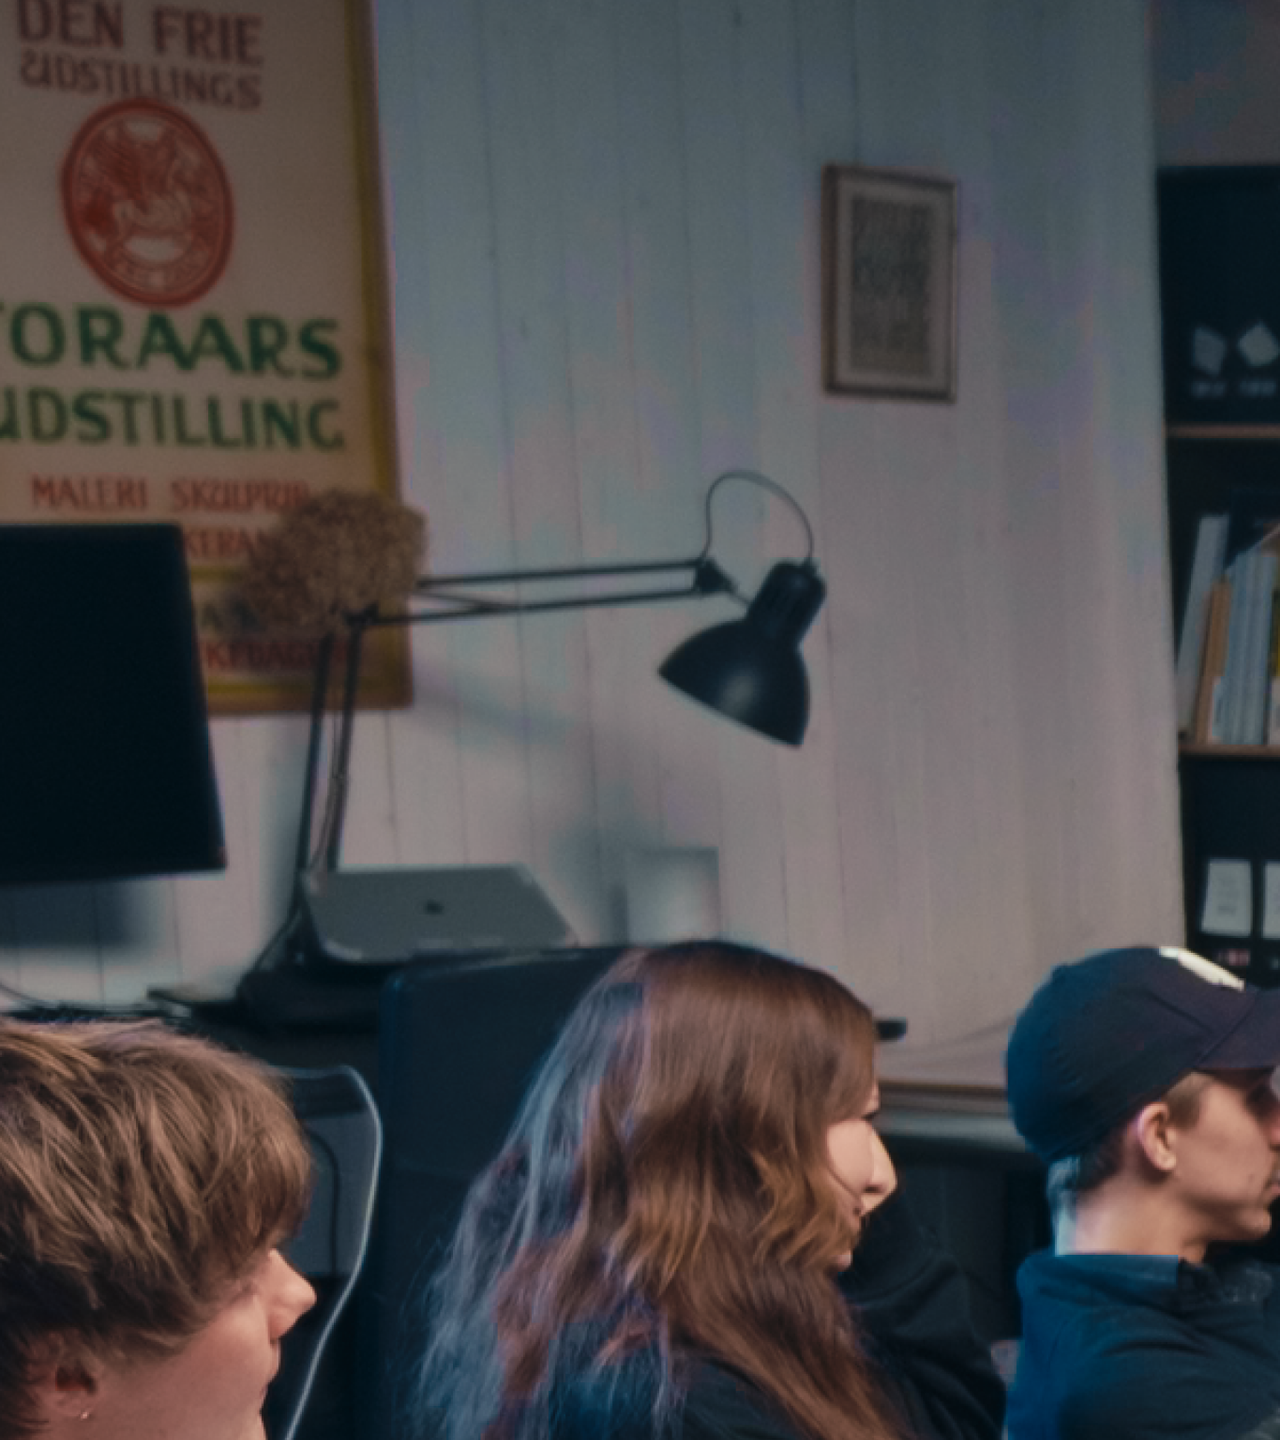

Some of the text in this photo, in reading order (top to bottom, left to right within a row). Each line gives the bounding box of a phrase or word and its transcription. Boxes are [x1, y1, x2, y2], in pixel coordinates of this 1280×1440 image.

[152, 5, 263, 66] FRIE
[20, 48, 262, 110] UDSTILLINGS
[0, 303, 343, 379] ORAARS
[30, 472, 149, 510] MALERI
